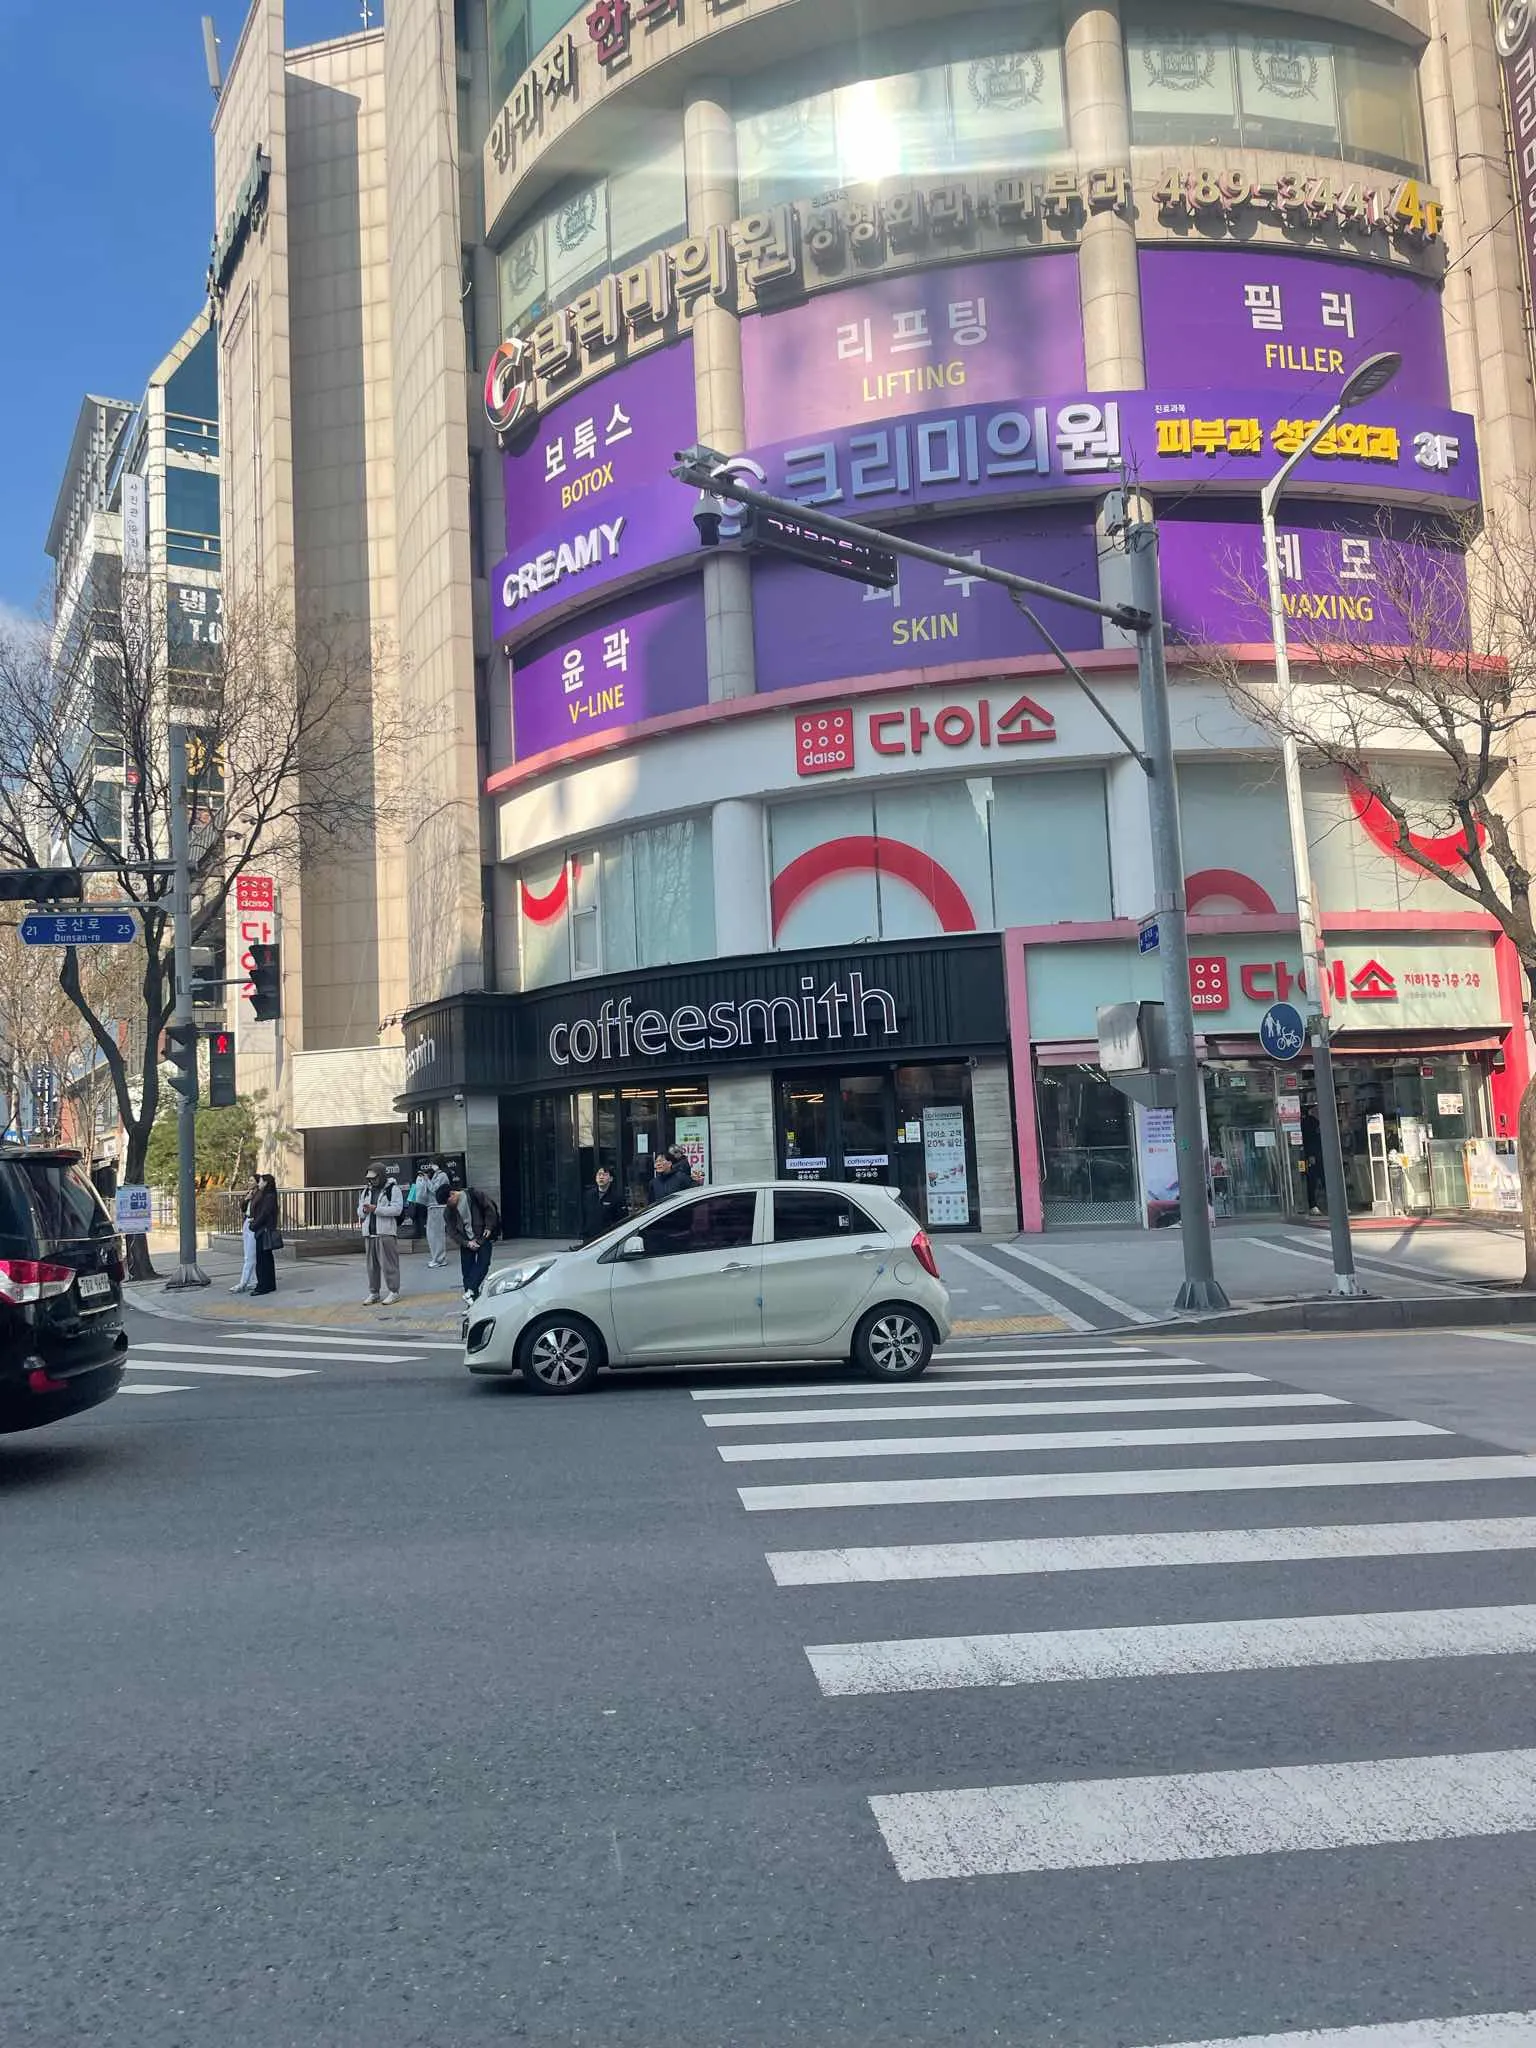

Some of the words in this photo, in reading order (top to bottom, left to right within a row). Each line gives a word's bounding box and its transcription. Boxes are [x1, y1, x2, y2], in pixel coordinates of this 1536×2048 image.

[533, 203, 798, 376] 크리미의원
[1244, 285, 1355, 338] 필러
[837, 298, 988, 362] 리프팅
[863, 361, 966, 402] LIFTING
[1265, 344, 1344, 374] FILLER
[545, 403, 632, 482] 보톡스
[784, 401, 1121, 507] 크리미의원
[1156, 418, 1262, 457] 피부과
[1413, 431, 1459, 471] 3F
[561, 461, 614, 509] BOTOX
[503, 516, 626, 608] CREAMY
[892, 611, 958, 645] SKIN
[562, 628, 629, 693] 윤곽
[568, 684, 624, 724] V-LINE
[869, 695, 1056, 754] 다이소
[803, 750, 846, 767] daiso
[26, 926, 37, 936] 21
[55, 918, 101, 932] 둔산로
[117, 925, 131, 934] 25
[550, 971, 899, 1065] coffeesmith
[1192, 994, 1222, 1004] aiso
